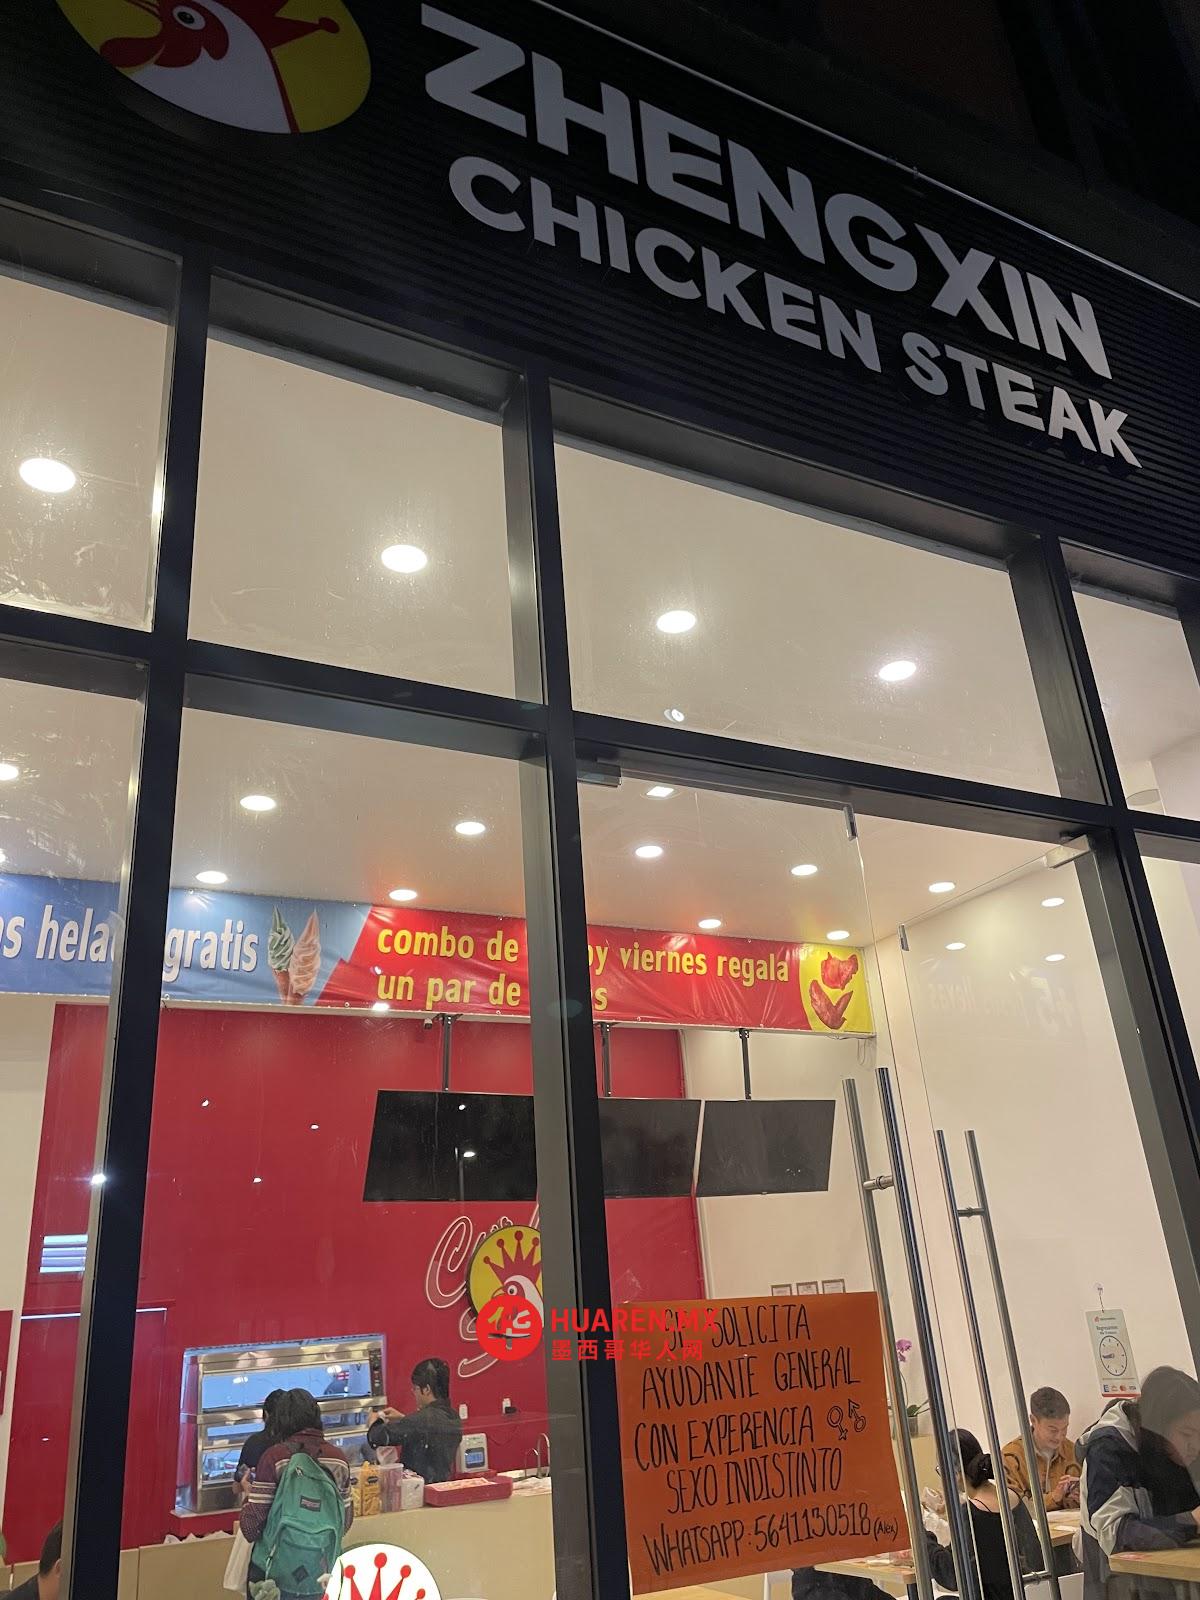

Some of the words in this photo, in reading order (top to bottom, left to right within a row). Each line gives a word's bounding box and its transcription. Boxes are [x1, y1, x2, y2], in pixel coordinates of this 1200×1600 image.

[421, 3, 1112, 379] ZHENGXIN
[448, 155, 882, 373] CHICKEN
[903, 331, 1142, 469] STEAK
[36, 904, 116, 962] hela
[163, 919, 260, 983] gratis
[377, 925, 475, 959] combo
[486, 930, 519, 962] de
[620, 941, 708, 975] viernes
[717, 953, 789, 987] regala
[377, 974, 414, 1001] un
[425, 976, 477, 1011] par
[488, 973, 521, 1007] de
[706, 1303, 812, 1348] SOLICITA
[641, 1355, 760, 1410] AYUDANTE
[773, 1346, 861, 1392] GENERAL
[634, 1422, 679, 1472] CON
[687, 1405, 814, 1462] EXPERENCIA
[666, 1464, 719, 1514] SEXO
[725, 1447, 842, 1506] INDISTINTO
